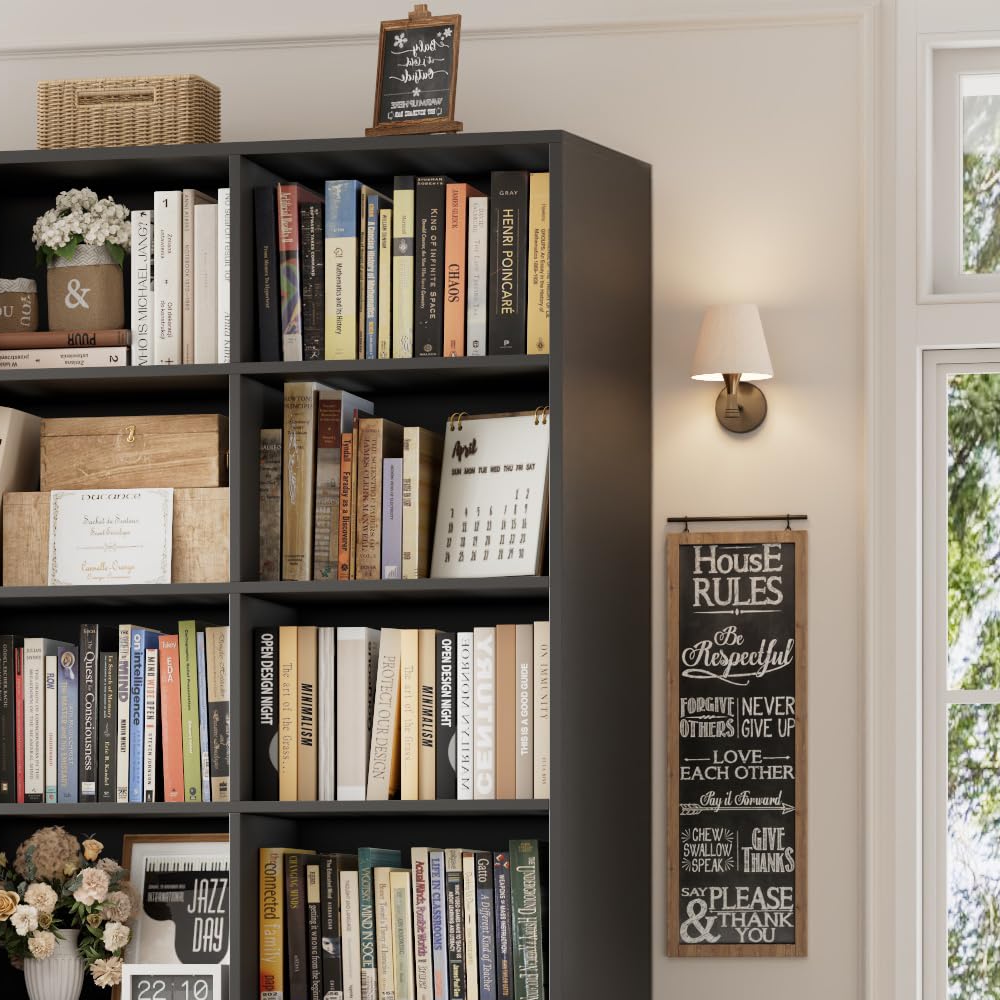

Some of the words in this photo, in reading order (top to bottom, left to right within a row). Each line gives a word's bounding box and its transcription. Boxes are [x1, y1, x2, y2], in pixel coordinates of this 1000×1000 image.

[429, 208, 438, 231] KING
[502, 208, 514, 246] HENRI
[137, 222, 149, 262] JANG?
[429, 235, 438, 246] OF
[429, 248, 438, 288] INFINITE
[64, 278, 90, 310] &
[137, 264, 149, 321] MICHAEL
[448, 263, 460, 303] CHAOS
[501, 250, 515, 315] POINCARÉ
[428, 291, 438, 320] SPACE
[67, 332, 96, 345] PUUR
[137, 323, 149, 335] IS
[137, 337, 149, 367] WHO
[452, 437, 478, 462] April
[692, 575, 784, 607] RULES
[134, 633, 141, 650] on
[261, 633, 274, 657] OPEN
[713, 625, 745, 646] Be
[82, 651, 96, 685] Quest
[681, 638, 795, 680] Respectful
[131, 651, 144, 726] intelligence
[261, 659, 274, 695] DESIGN
[260, 696, 274, 726] NIGHT
[300, 683, 313, 747] MINIMALISM
[680, 696, 735, 718] FORGIVE
[742, 696, 796, 717] NEVER
[84, 692, 96, 771] Consciousness
[680, 718, 735, 738] OTHERS
[741, 718, 773, 738] GIVE
[778, 717, 796, 738] UP
[713, 749, 763, 764] LOVE
[680, 766, 730, 780] EACH
[734, 765, 796, 780] OTHER
[700, 790, 722, 813] Pay
[724, 790, 733, 806] it
[734, 790, 783, 806] Forward
[692, 827, 724, 842] CHEW
[751, 826, 786, 851] GIVE
[683, 843, 733, 857] SWALLOW
[741, 846, 796, 873] THANKS
[477, 858, 490, 883] Gatto
[691, 858, 724, 873] SPEAK
[187, 877, 229, 914] JAZZ
[264, 862, 280, 921] connected
[681, 887, 708, 897] SAY
[708, 886, 794, 911] PLEASE
[680, 898, 721, 944] &
[717, 912, 795, 928] THANK
[192, 916, 223, 953] DAY
[734, 927, 776, 943] YOU
[137, 980, 167, 1000] 22
[182, 979, 209, 1000] 10
